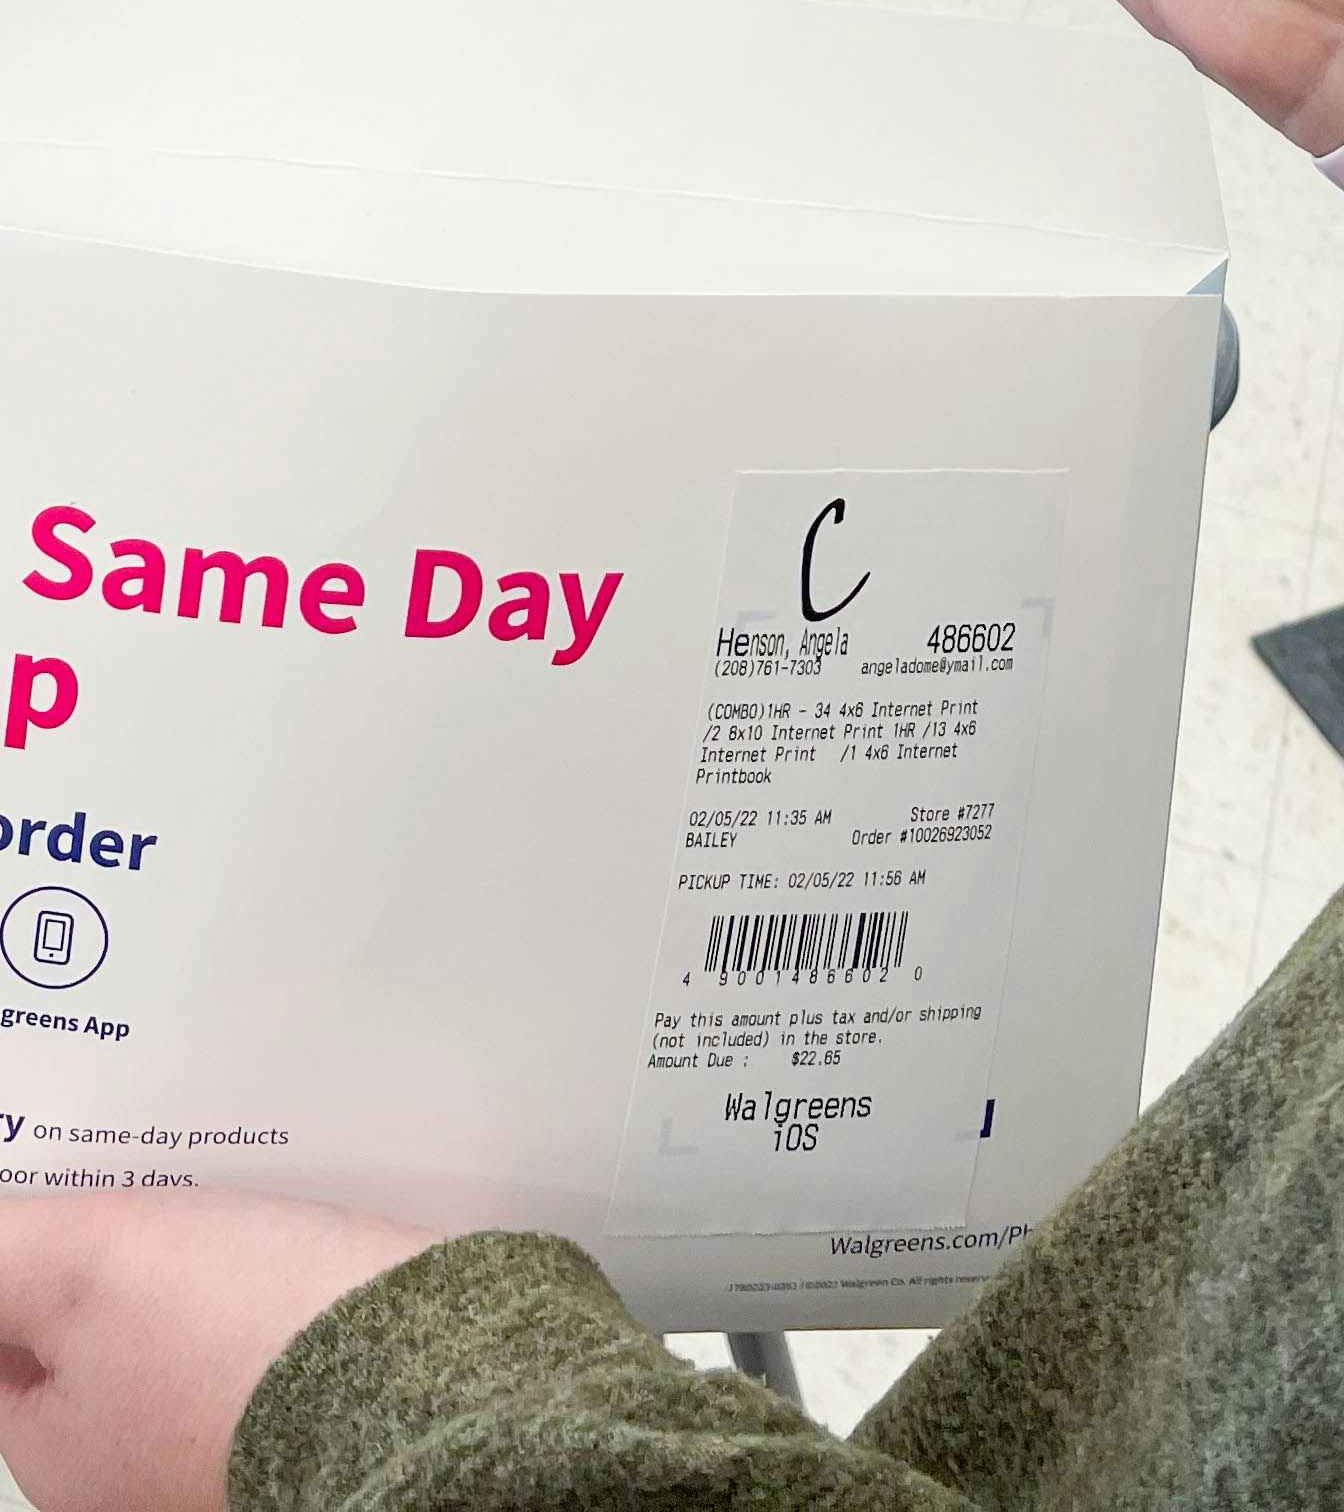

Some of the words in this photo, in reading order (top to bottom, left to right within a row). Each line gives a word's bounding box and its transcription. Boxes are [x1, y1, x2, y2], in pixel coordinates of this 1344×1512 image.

[801, 497, 871, 623] C
[22, 505, 366, 635] Same
[404, 548, 625, 667] Day
[715, 627, 790, 660] Henson,
[798, 626, 849, 661] Angela
[926, 622, 1017, 654] 486602
[713, 658, 823, 678] (208)761-7303
[707, 702, 791, 720] (COMBO)1HR
[814, 702, 831, 718] 34
[839, 701, 864, 718] 4x6
[871, 700, 933, 717] Internet
[939, 698, 979, 716] Print
[702, 723, 721, 742] /2
[728, 724, 763, 741] 8x10
[771, 723, 836, 741] Internet
[843, 722, 883, 739] Print
[893, 721, 916, 737] 1HR
[921, 720, 947, 738] /13
[953, 719, 977, 737] 4x6
[700, 745, 767, 763] Internet
[774, 745, 817, 763] Print
[839, 743, 857, 762] /1
[864, 743, 889, 760] 4x6
[896, 740, 958, 760] Internet
[695, 768, 773, 785] Printbook
[688, 810, 758, 826] 02/05/22
[767, 810, 807, 826] 11:35
[814, 809, 832, 824] AM
[910, 805, 950, 823] Store
[957, 802, 996, 820] #7277
[685, 831, 738, 848] BAILEY
[851, 828, 893, 846] Order
[899, 824, 993, 843] #10026923052
[678, 873, 731, 890] PICKUP
[739, 872, 780, 890] TIME:
[787, 871, 855, 888] 02/05/22
[863, 870, 902, 886] 11:56
[909, 869, 927, 885] AM
[654, 1012, 681, 1029] Pay
[690, 1011, 723, 1027] this
[731, 1012, 781, 1027] amount
[789, 1011, 824, 1029] plus
[832, 1011, 856, 1025] tax
[863, 1007, 912, 1025] and/or
[919, 1004, 982, 1023] shipping
[83, 1015, 131, 1042] App
[652, 1032, 686, 1050] (not
[695, 1030, 769, 1050] included)
[780, 1032, 797, 1046] in
[803, 1030, 828, 1046] the
[835, 1029, 883, 1045] store.
[647, 1052, 698, 1069] Amount
[706, 1051, 734, 1067] Due
[791, 1050, 841, 1066] $22.65
[724, 1090, 873, 1125] Walgreens
[32, 1121, 62, 1141] on
[68, 1125, 183, 1150] same-day
[187, 1126, 290, 1149] products
[773, 1122, 819, 1153] iOS
[43, 1169, 115, 1188] within
[121, 1170, 135, 1188] 3
